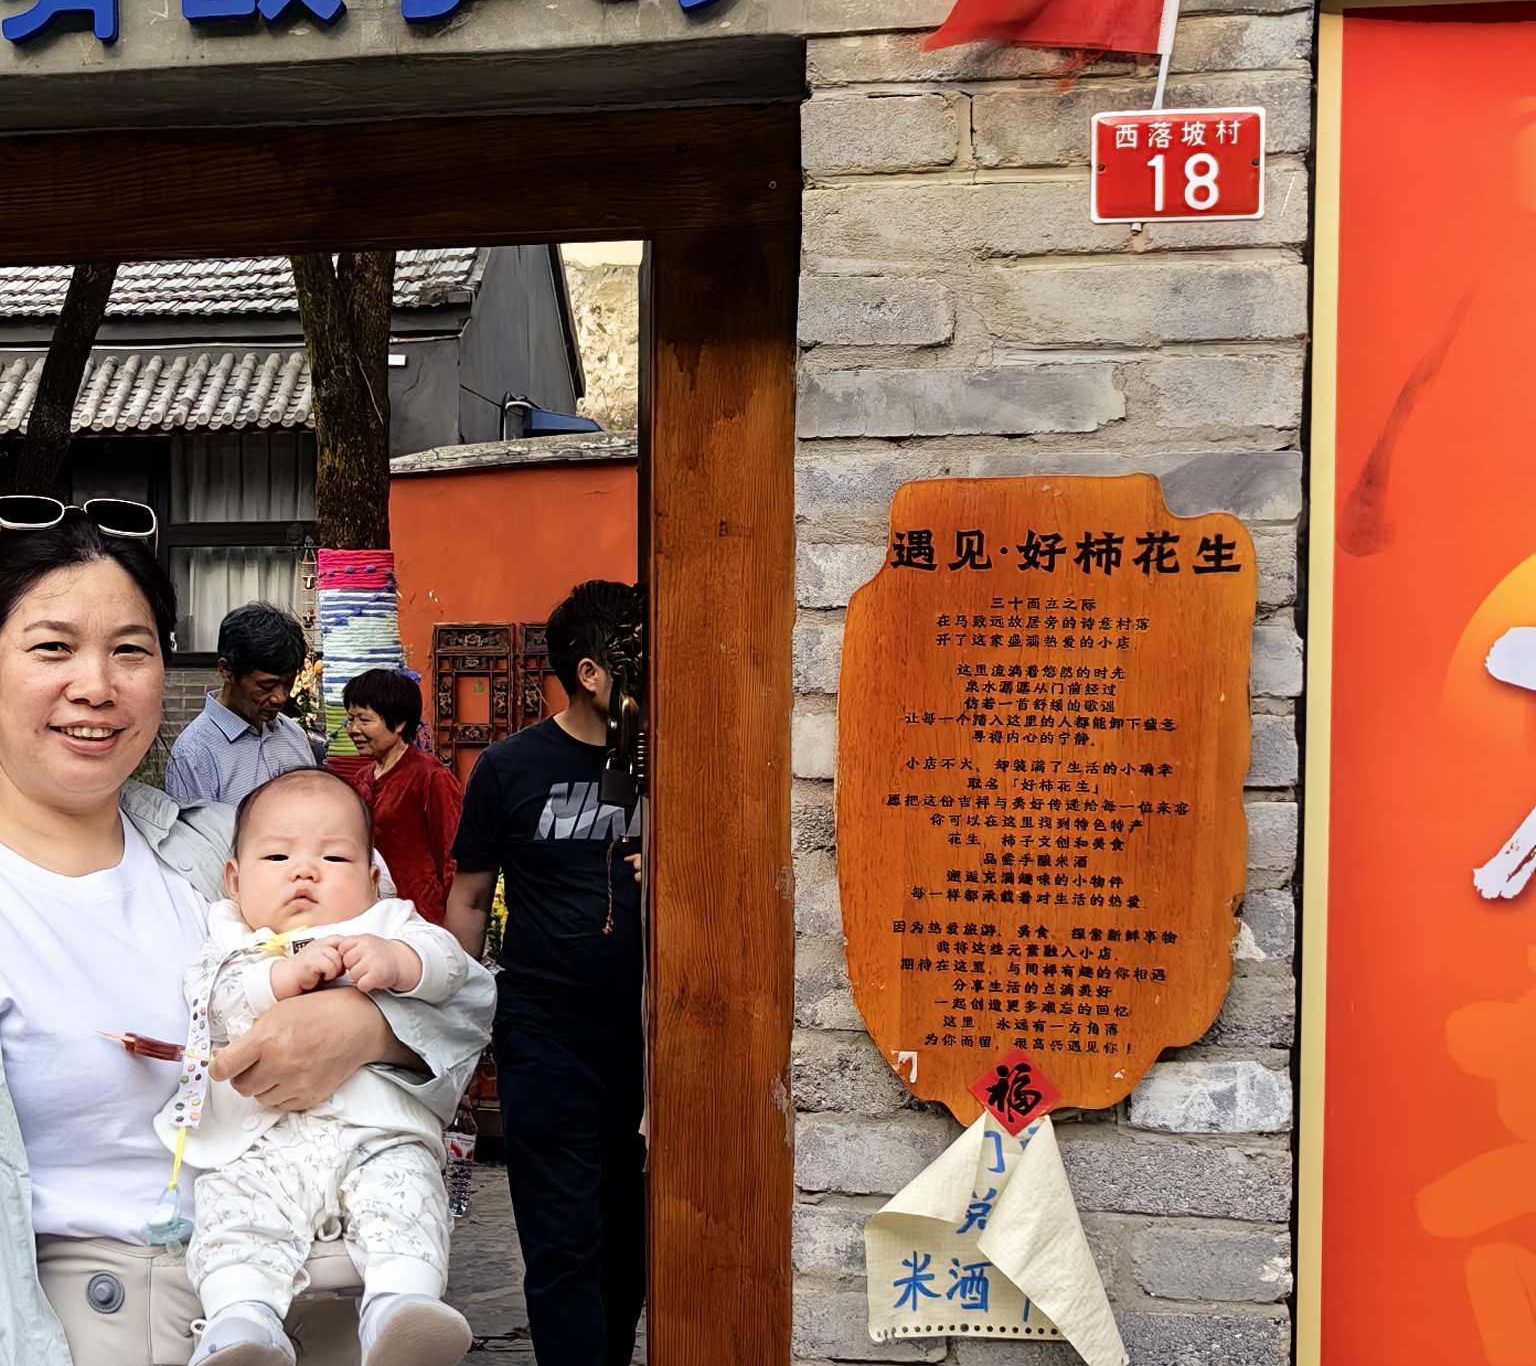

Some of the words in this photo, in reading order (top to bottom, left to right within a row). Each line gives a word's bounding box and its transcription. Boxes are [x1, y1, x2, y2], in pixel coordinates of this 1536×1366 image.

[1115, 120, 1241, 149] 西落坡村
[1147, 153, 1219, 211] 18
[990, 597, 1096, 611] 三十而立之际
[936, 614, 1151, 631] 在马致远故居旁的诗意村落
[965, 681, 1117, 696] 泉水潺潺从门前经过
[964, 698, 1116, 713] 仿若一首舒缓的歌谣
[929, 814, 1144, 834] 你可以在这里找到特色特产
[982, 852, 1089, 869] 品尝手酿米酒
[946, 868, 1125, 889] 邂逅充满趣味的小物件
[953, 978, 1113, 999] 分享生活的点滴美好
[934, 996, 1130, 1018] 一起创造更多难忘的回忆
[985, 1063, 1042, 1123] 福
